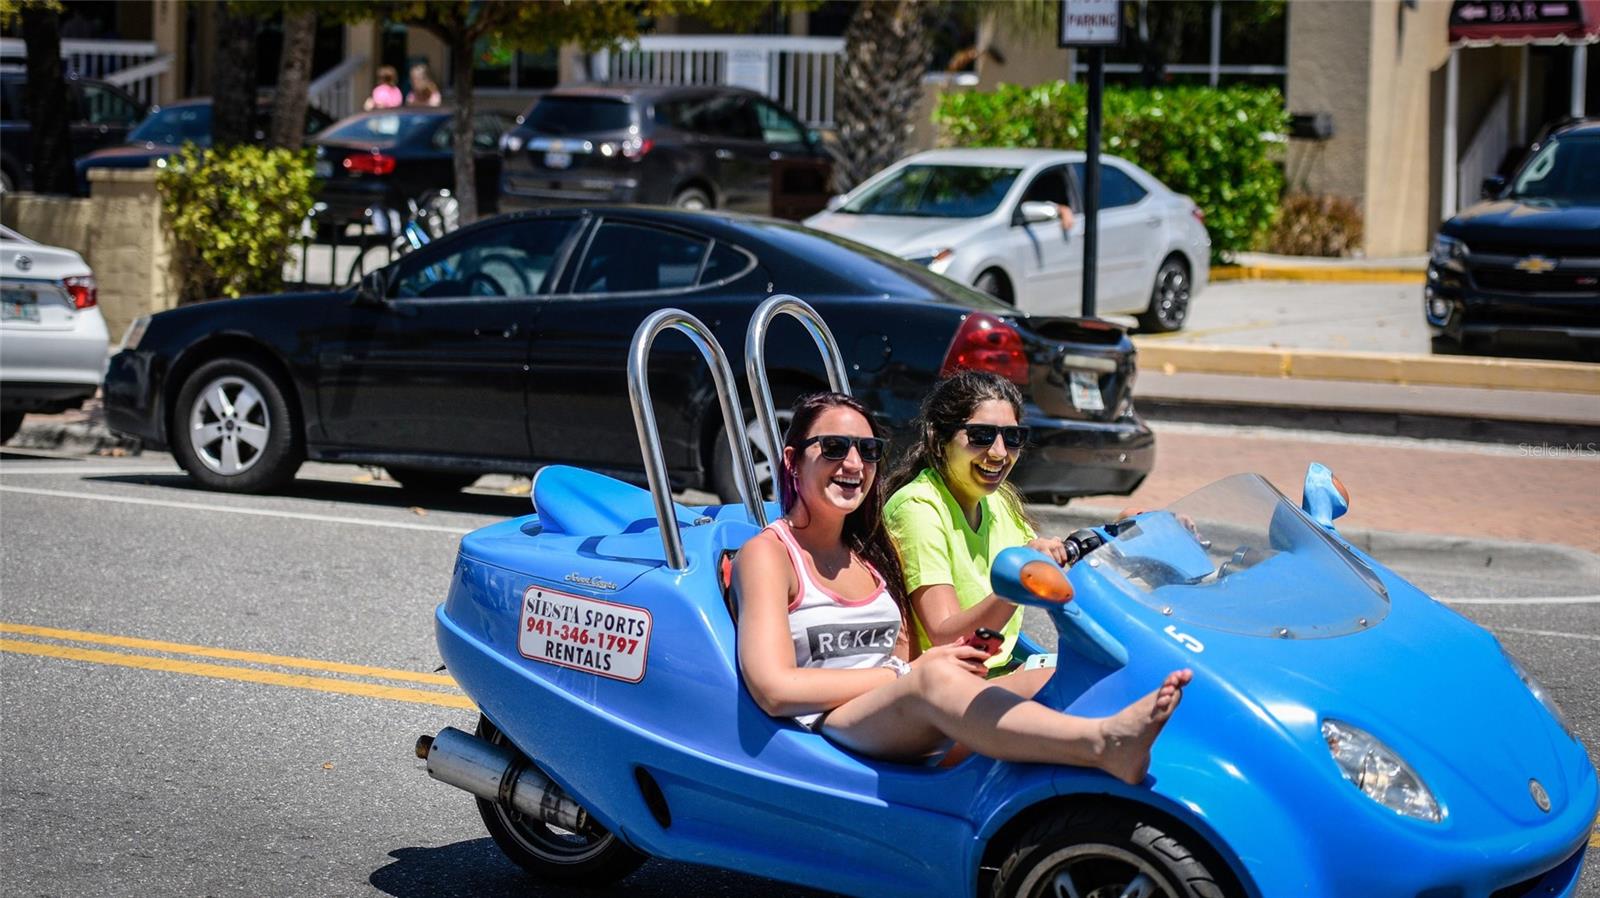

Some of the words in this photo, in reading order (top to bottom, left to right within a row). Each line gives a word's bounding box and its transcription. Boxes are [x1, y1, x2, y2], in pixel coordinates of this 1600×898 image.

[1066, 14, 1117, 27] PARKING
[1490, 2, 1536, 20] BAR
[527, 616, 639, 655] 941-346-1797
[585, 609, 645, 637] SPORTS
[818, 628, 895, 653] RCKLS
[1163, 624, 1205, 653] 5
[546, 640, 611, 671] RENTALS
